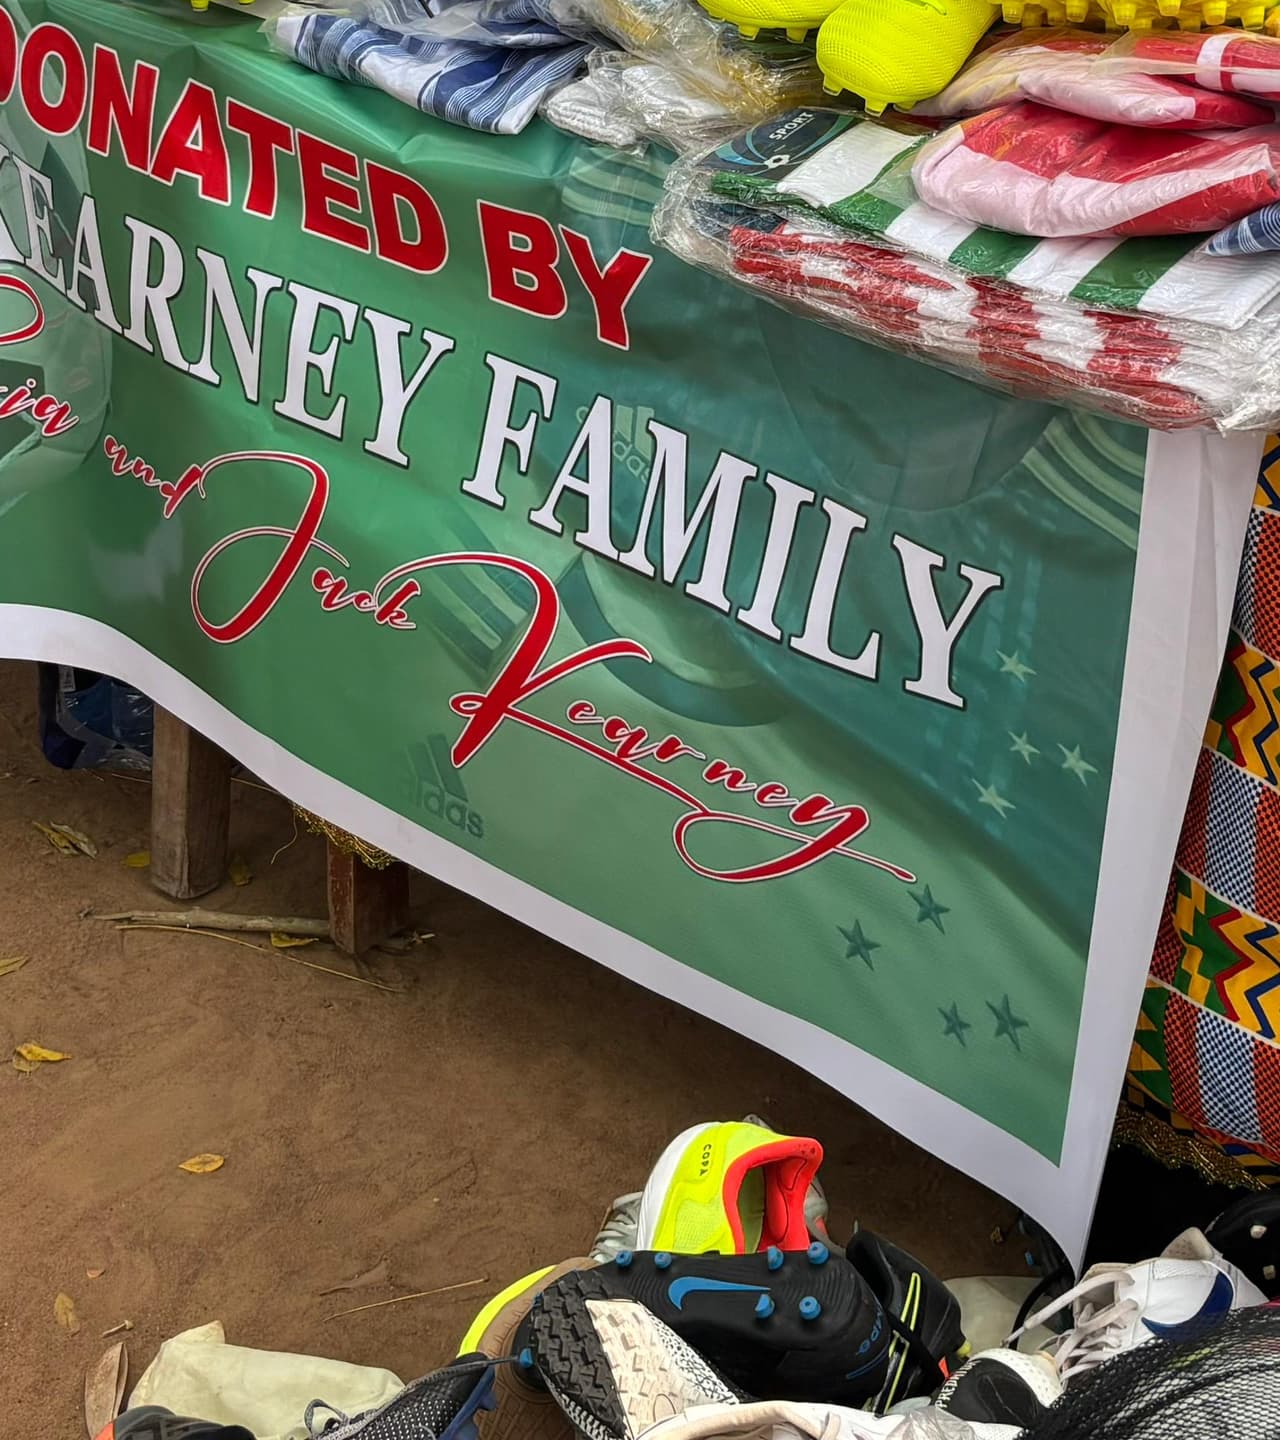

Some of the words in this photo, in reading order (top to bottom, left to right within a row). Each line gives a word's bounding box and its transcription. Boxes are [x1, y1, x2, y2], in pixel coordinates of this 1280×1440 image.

[768, 112, 815, 141] SPORT
[477, 203, 652, 351] BY
[460, 352, 1003, 711] FAMILY
[104, 434, 203, 519] and
[192, 449, 421, 645] Jack
[373, 550, 917, 884] Kearney
[699, 1143, 713, 1177] COPA
